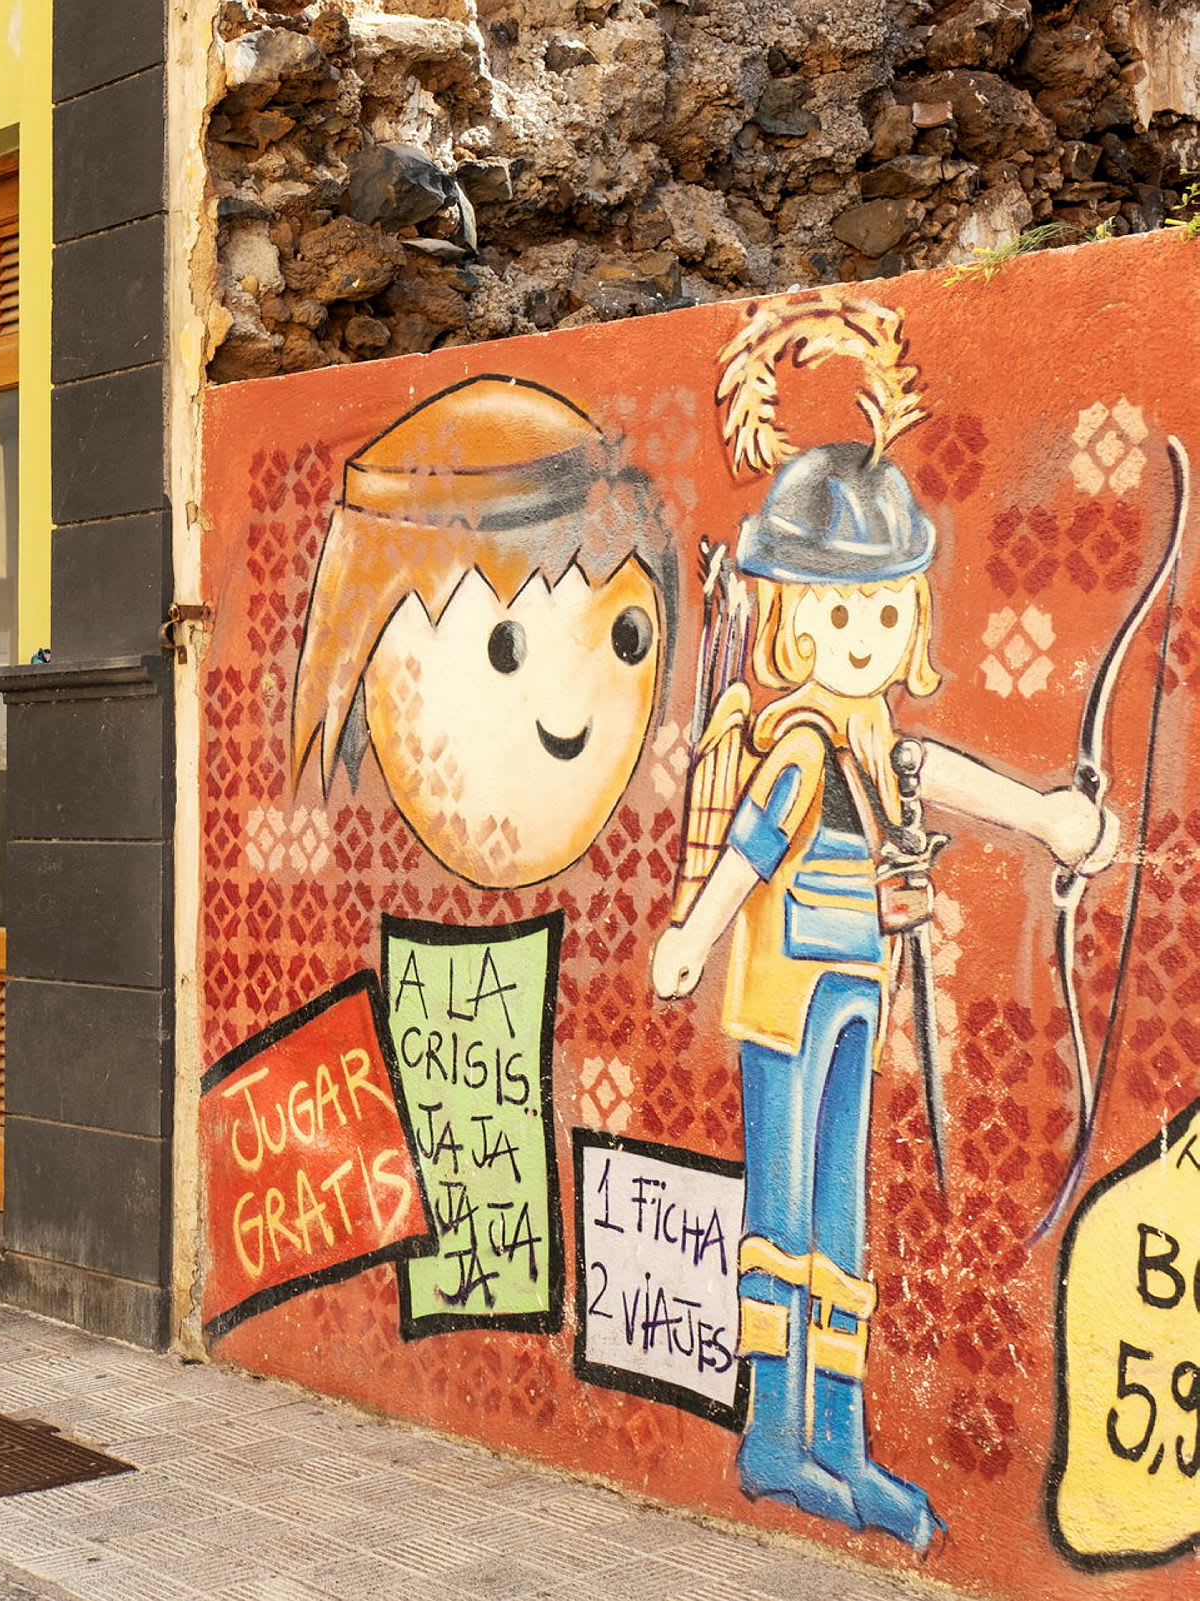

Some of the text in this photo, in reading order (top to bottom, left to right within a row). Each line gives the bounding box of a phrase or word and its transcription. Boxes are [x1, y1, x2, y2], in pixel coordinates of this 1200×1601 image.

[395, 946, 517, 1039] A LA
[221, 1048, 397, 1172] JUGAR
[416, 1101, 522, 1184] JA JA
[233, 1146, 413, 1279] GRATIS
[435, 1181, 542, 1283] JA JA
[594, 1158, 625, 1234] 1
[434, 1249, 500, 1309] JA
[588, 1261, 614, 1319] 2
